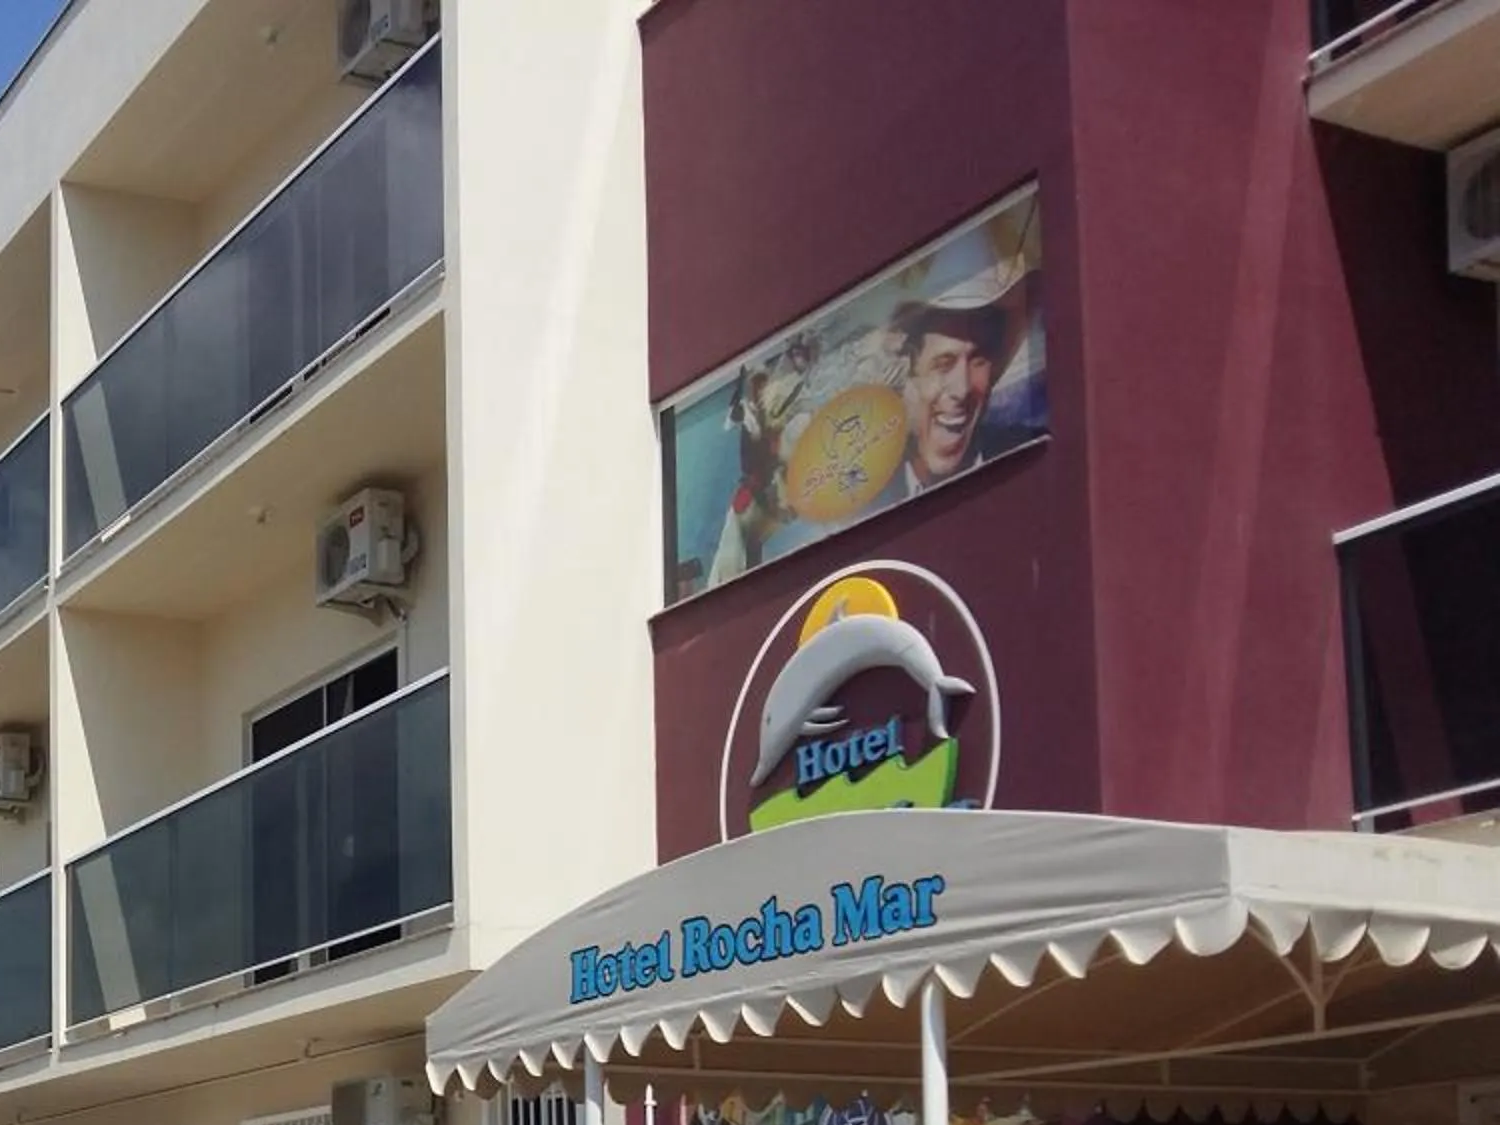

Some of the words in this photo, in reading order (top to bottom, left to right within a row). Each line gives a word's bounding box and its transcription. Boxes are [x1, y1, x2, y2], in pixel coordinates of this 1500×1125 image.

[796, 717, 905, 785] Hotel
[570, 930, 675, 1004] Hotel
[681, 896, 824, 977] Rocha
[832, 874, 946, 947] Mar
